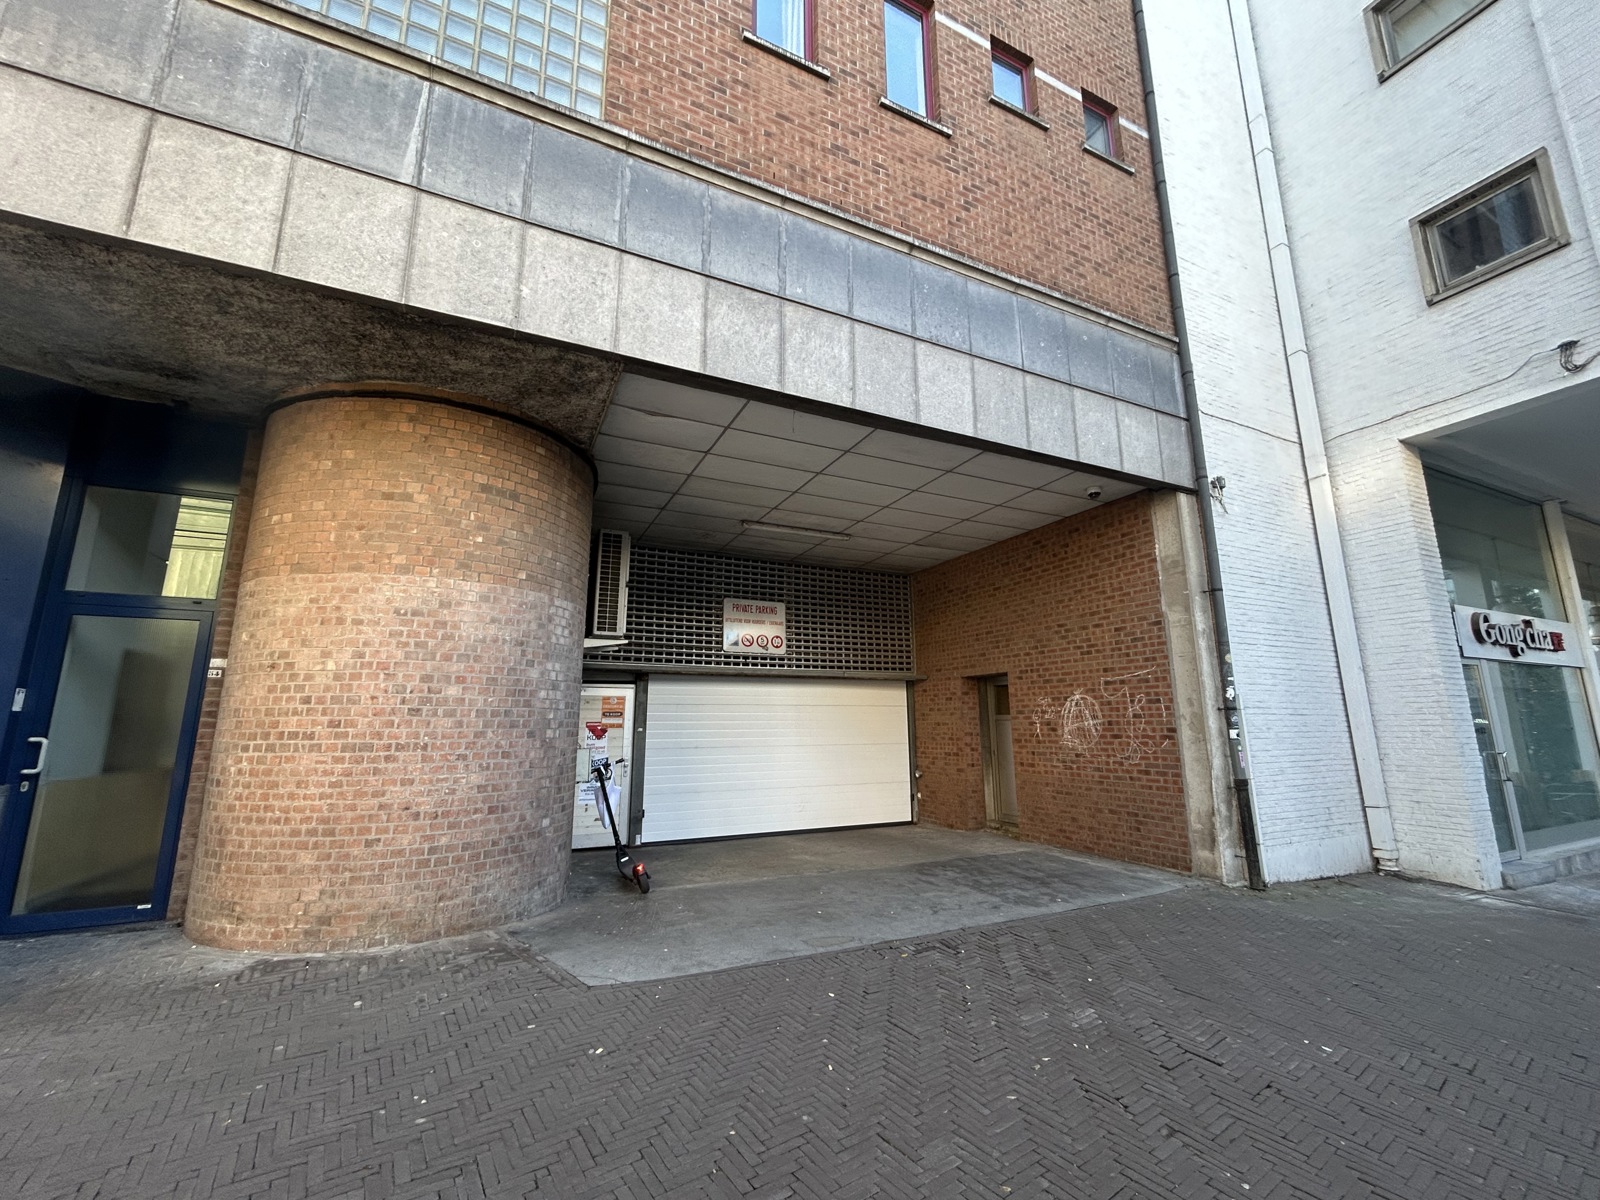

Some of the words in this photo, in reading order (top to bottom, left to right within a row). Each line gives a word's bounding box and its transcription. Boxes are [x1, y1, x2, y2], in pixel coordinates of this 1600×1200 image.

[732, 603, 753, 613] PRIVATE
[756, 605, 777, 615] PARKING
[1472, 612, 1526, 657] Gong
[1525, 619, 1554, 649] cha
